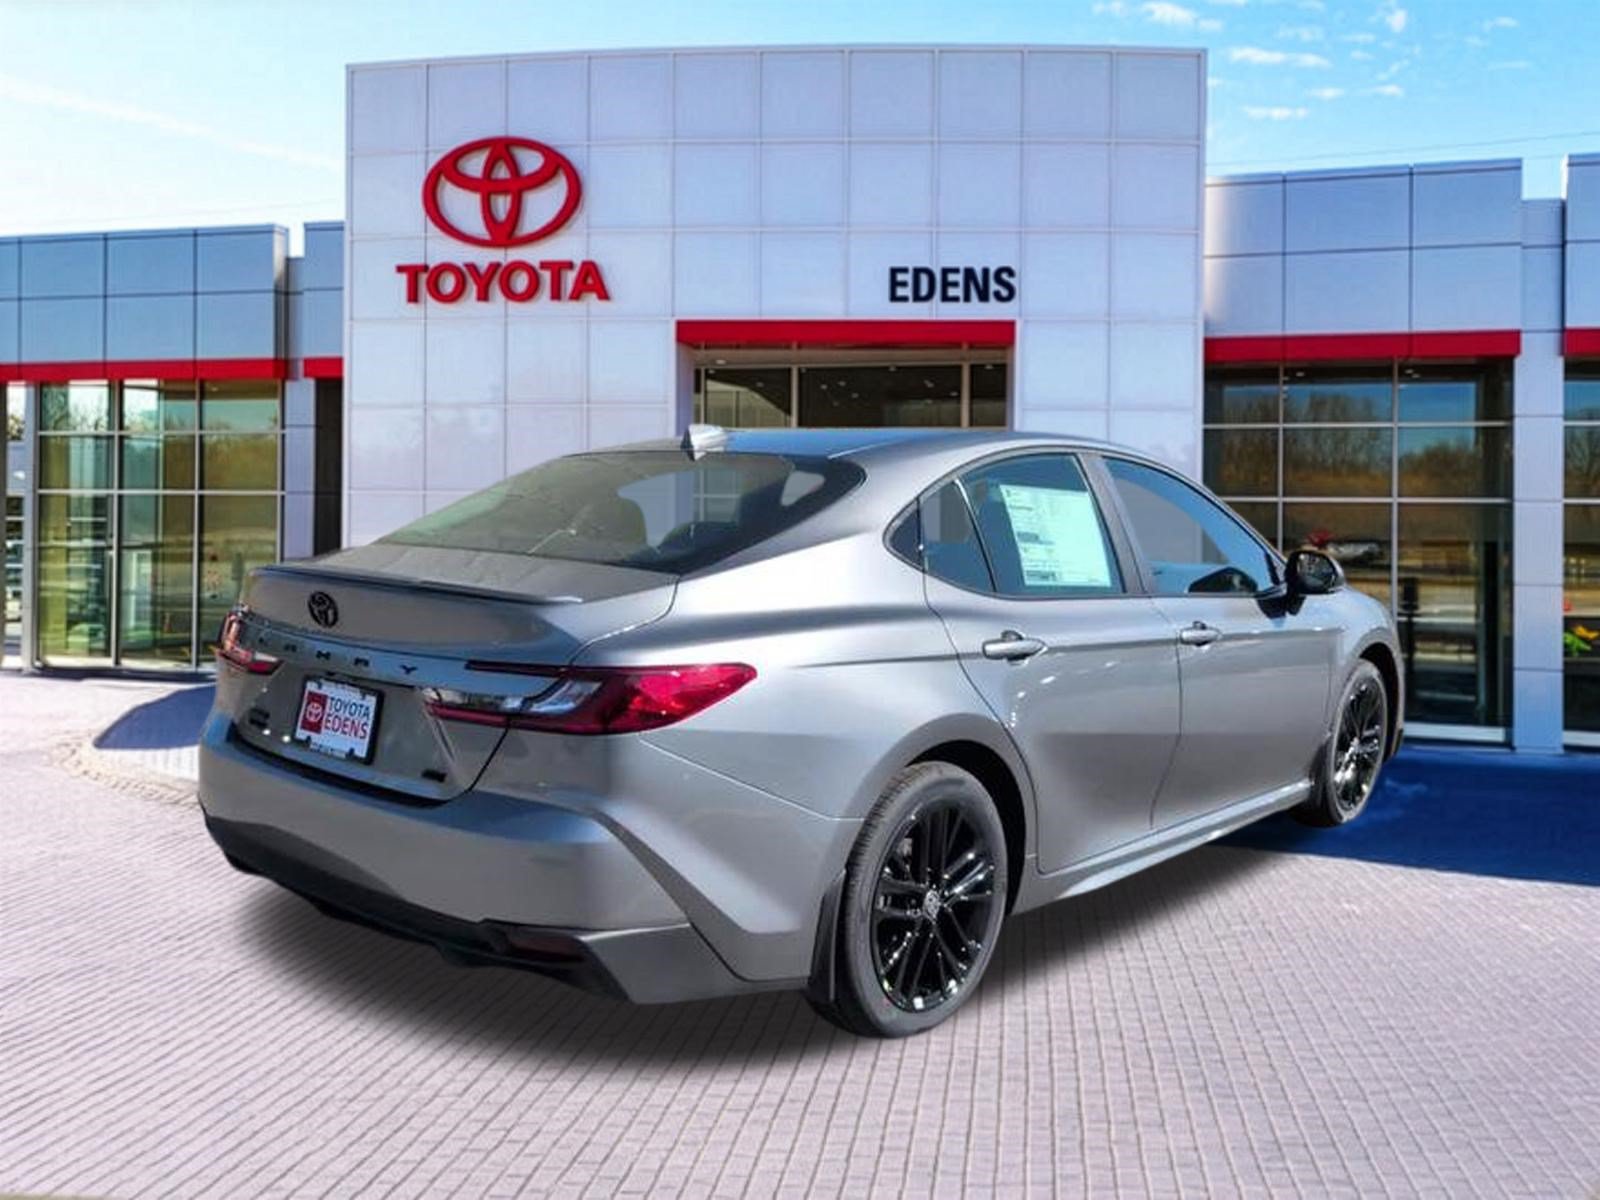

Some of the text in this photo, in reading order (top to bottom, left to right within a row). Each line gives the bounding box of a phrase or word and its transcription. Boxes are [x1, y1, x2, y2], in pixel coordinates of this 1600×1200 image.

[396, 260, 611, 304] TOYOTA
[889, 266, 1017, 303] EDENS
[328, 696, 371, 721] TOYOTA
[324, 713, 369, 740] EDENS
